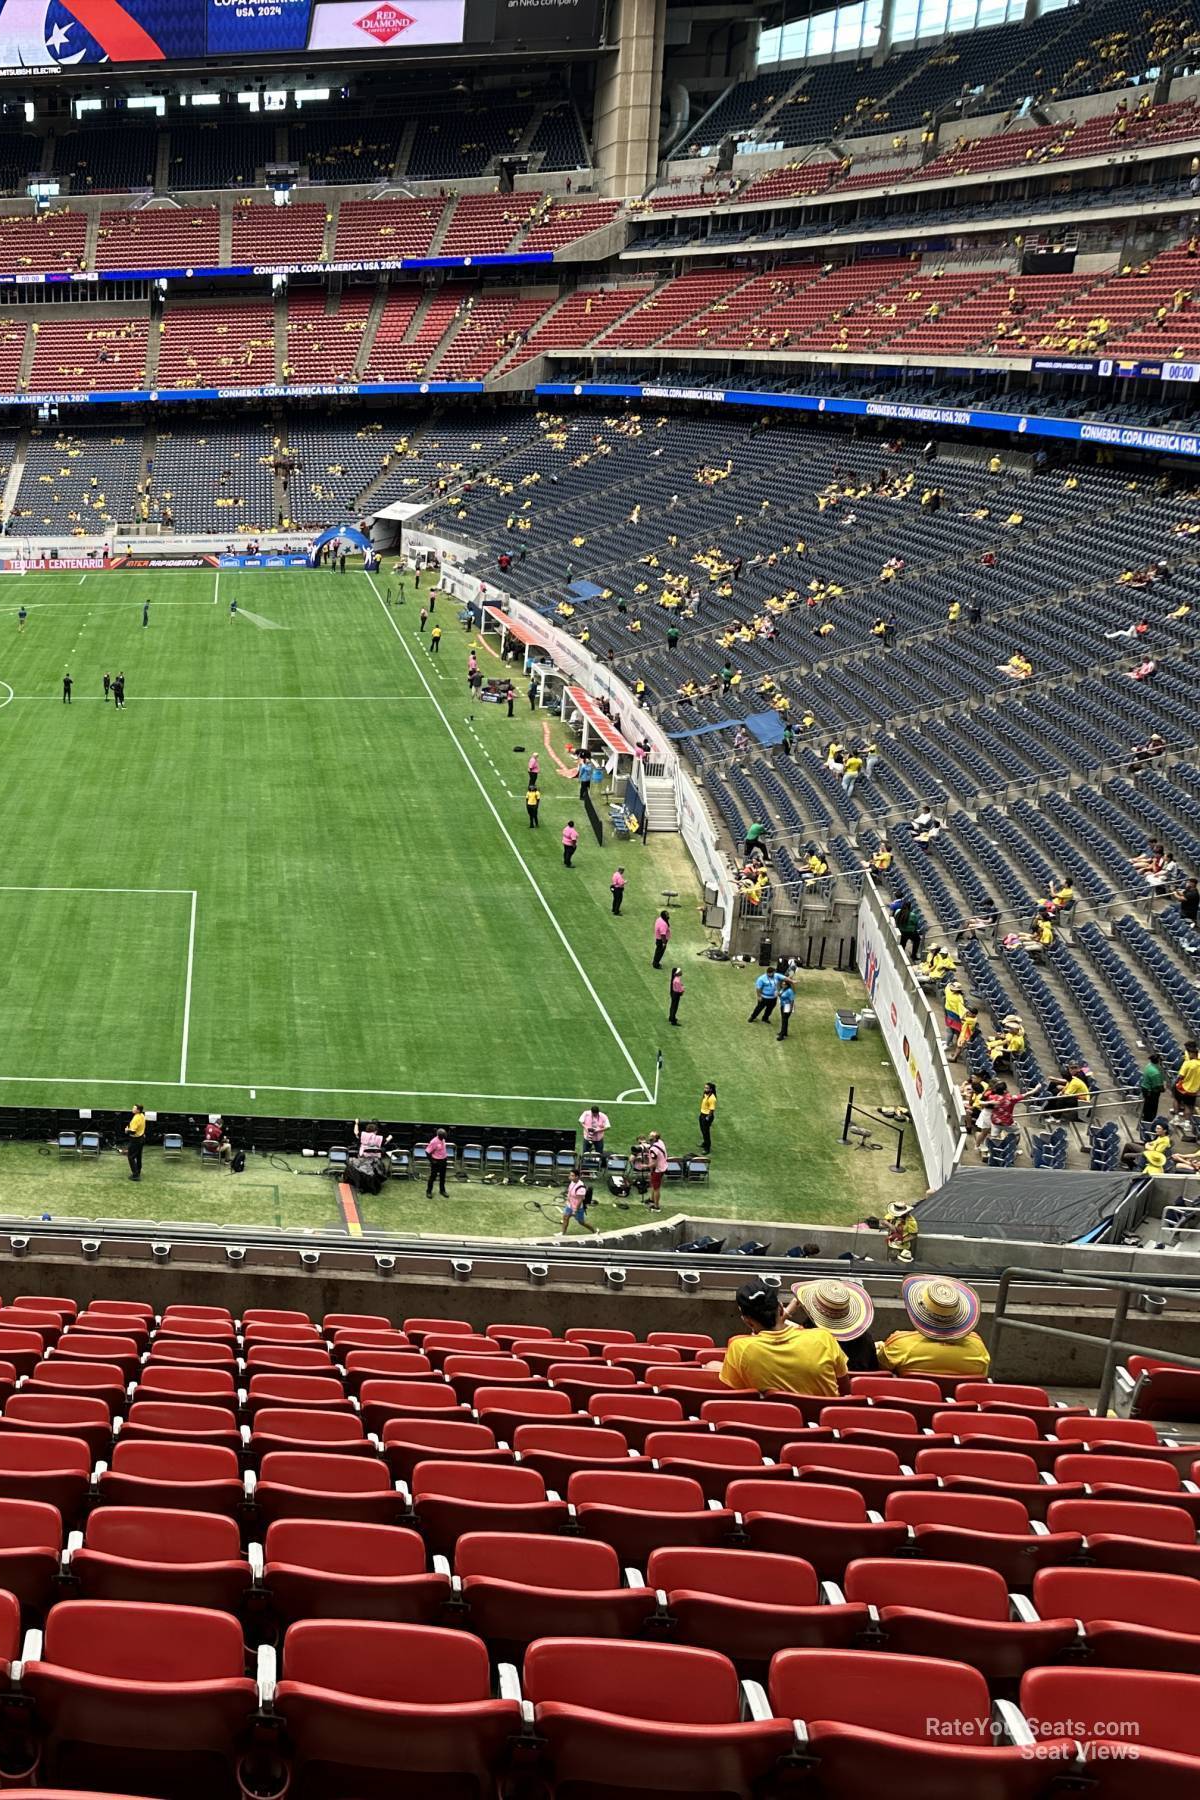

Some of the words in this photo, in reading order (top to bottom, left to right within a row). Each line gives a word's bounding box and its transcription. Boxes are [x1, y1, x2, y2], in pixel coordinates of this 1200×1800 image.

[236, 8, 254, 17] USA
[258, 7, 281, 16] 2024
[376, 11, 396, 20] RED
[362, 18, 410, 28] DIAMOND
[33, 67, 61, 75] ELECTRIC
[254, 266, 300, 274] CONMEBOL
[301, 265, 324, 273] COPA
[325, 262, 362, 272] AMERICA
[364, 262, 380, 270] USA
[381, 260, 402, 269] 2024
[1169, 366, 1193, 378] 00:00
[218, 390, 262, 398] CONMEBOL
[264, 388, 287, 396] COPA
[288, 387, 322, 396] AMERICA
[338, 386, 358, 394] 2024
[0, 396, 20, 404] COPA
[20, 395, 54, 403] AMERICA
[55, 394, 70, 402] USA
[866, 404, 898, 416] CONMEBOL
[914, 407, 941, 421] AMERICA
[1080, 425, 1120, 442] CONMEBOL
[1122, 430, 1142, 446] COPA
[1142, 432, 1180, 450] AMERICA
[1180, 438, 1197, 454] USA
[49, 560, 104, 568] CENTENARIO
